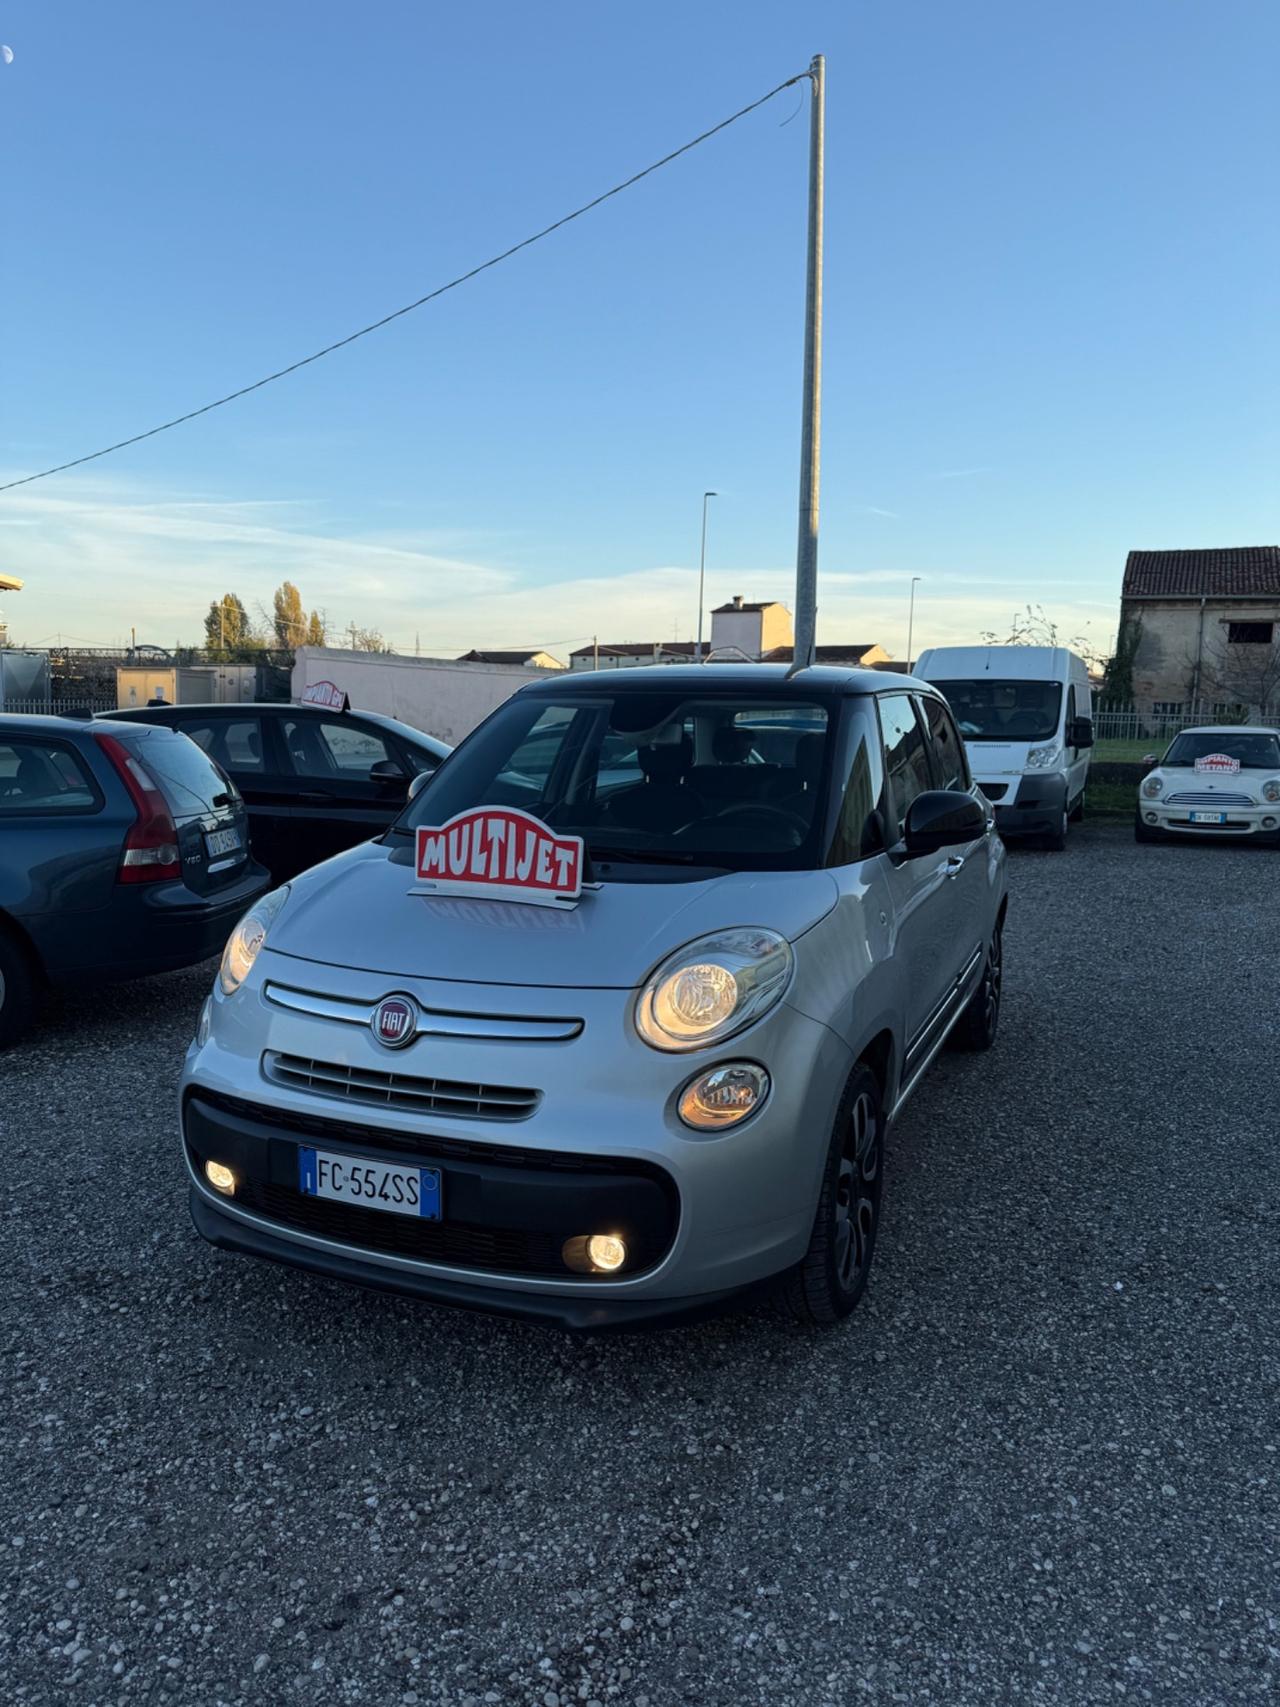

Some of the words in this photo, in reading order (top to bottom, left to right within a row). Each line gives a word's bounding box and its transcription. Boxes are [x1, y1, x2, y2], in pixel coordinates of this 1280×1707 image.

[421, 817, 575, 886] MULTIJET
[382, 1011, 405, 1032] FIAT
[318, 1159, 342, 1191] FC
[350, 1166, 418, 1205] 554SS
